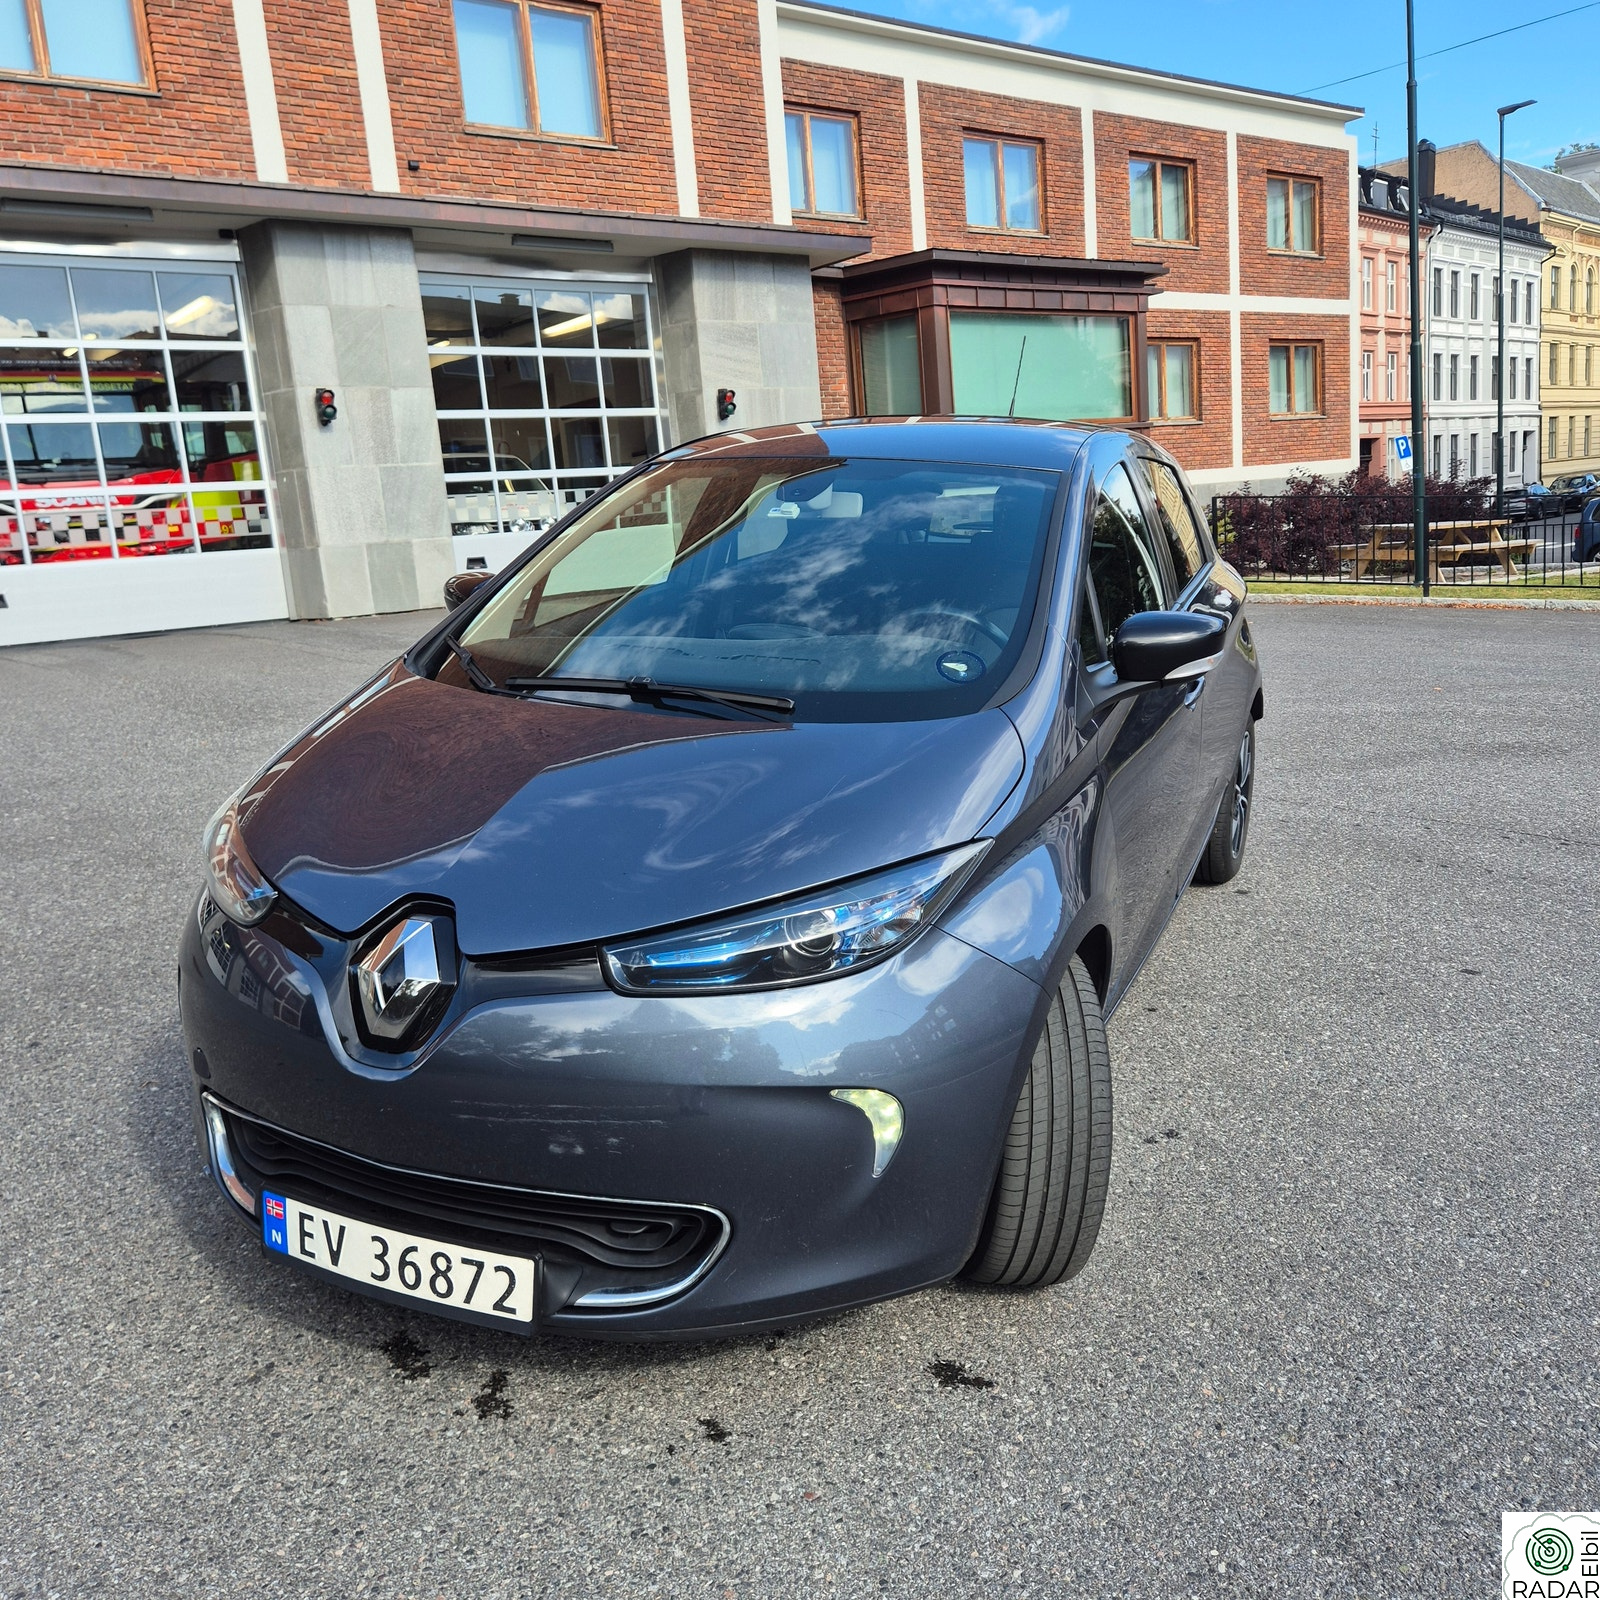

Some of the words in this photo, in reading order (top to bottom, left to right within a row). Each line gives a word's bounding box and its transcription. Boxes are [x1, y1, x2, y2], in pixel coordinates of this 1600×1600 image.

[1398, 439, 1406, 456] P
[272, 1229, 281, 1245] N
[298, 1211, 347, 1267] EV
[370, 1235, 518, 1316] 36872
